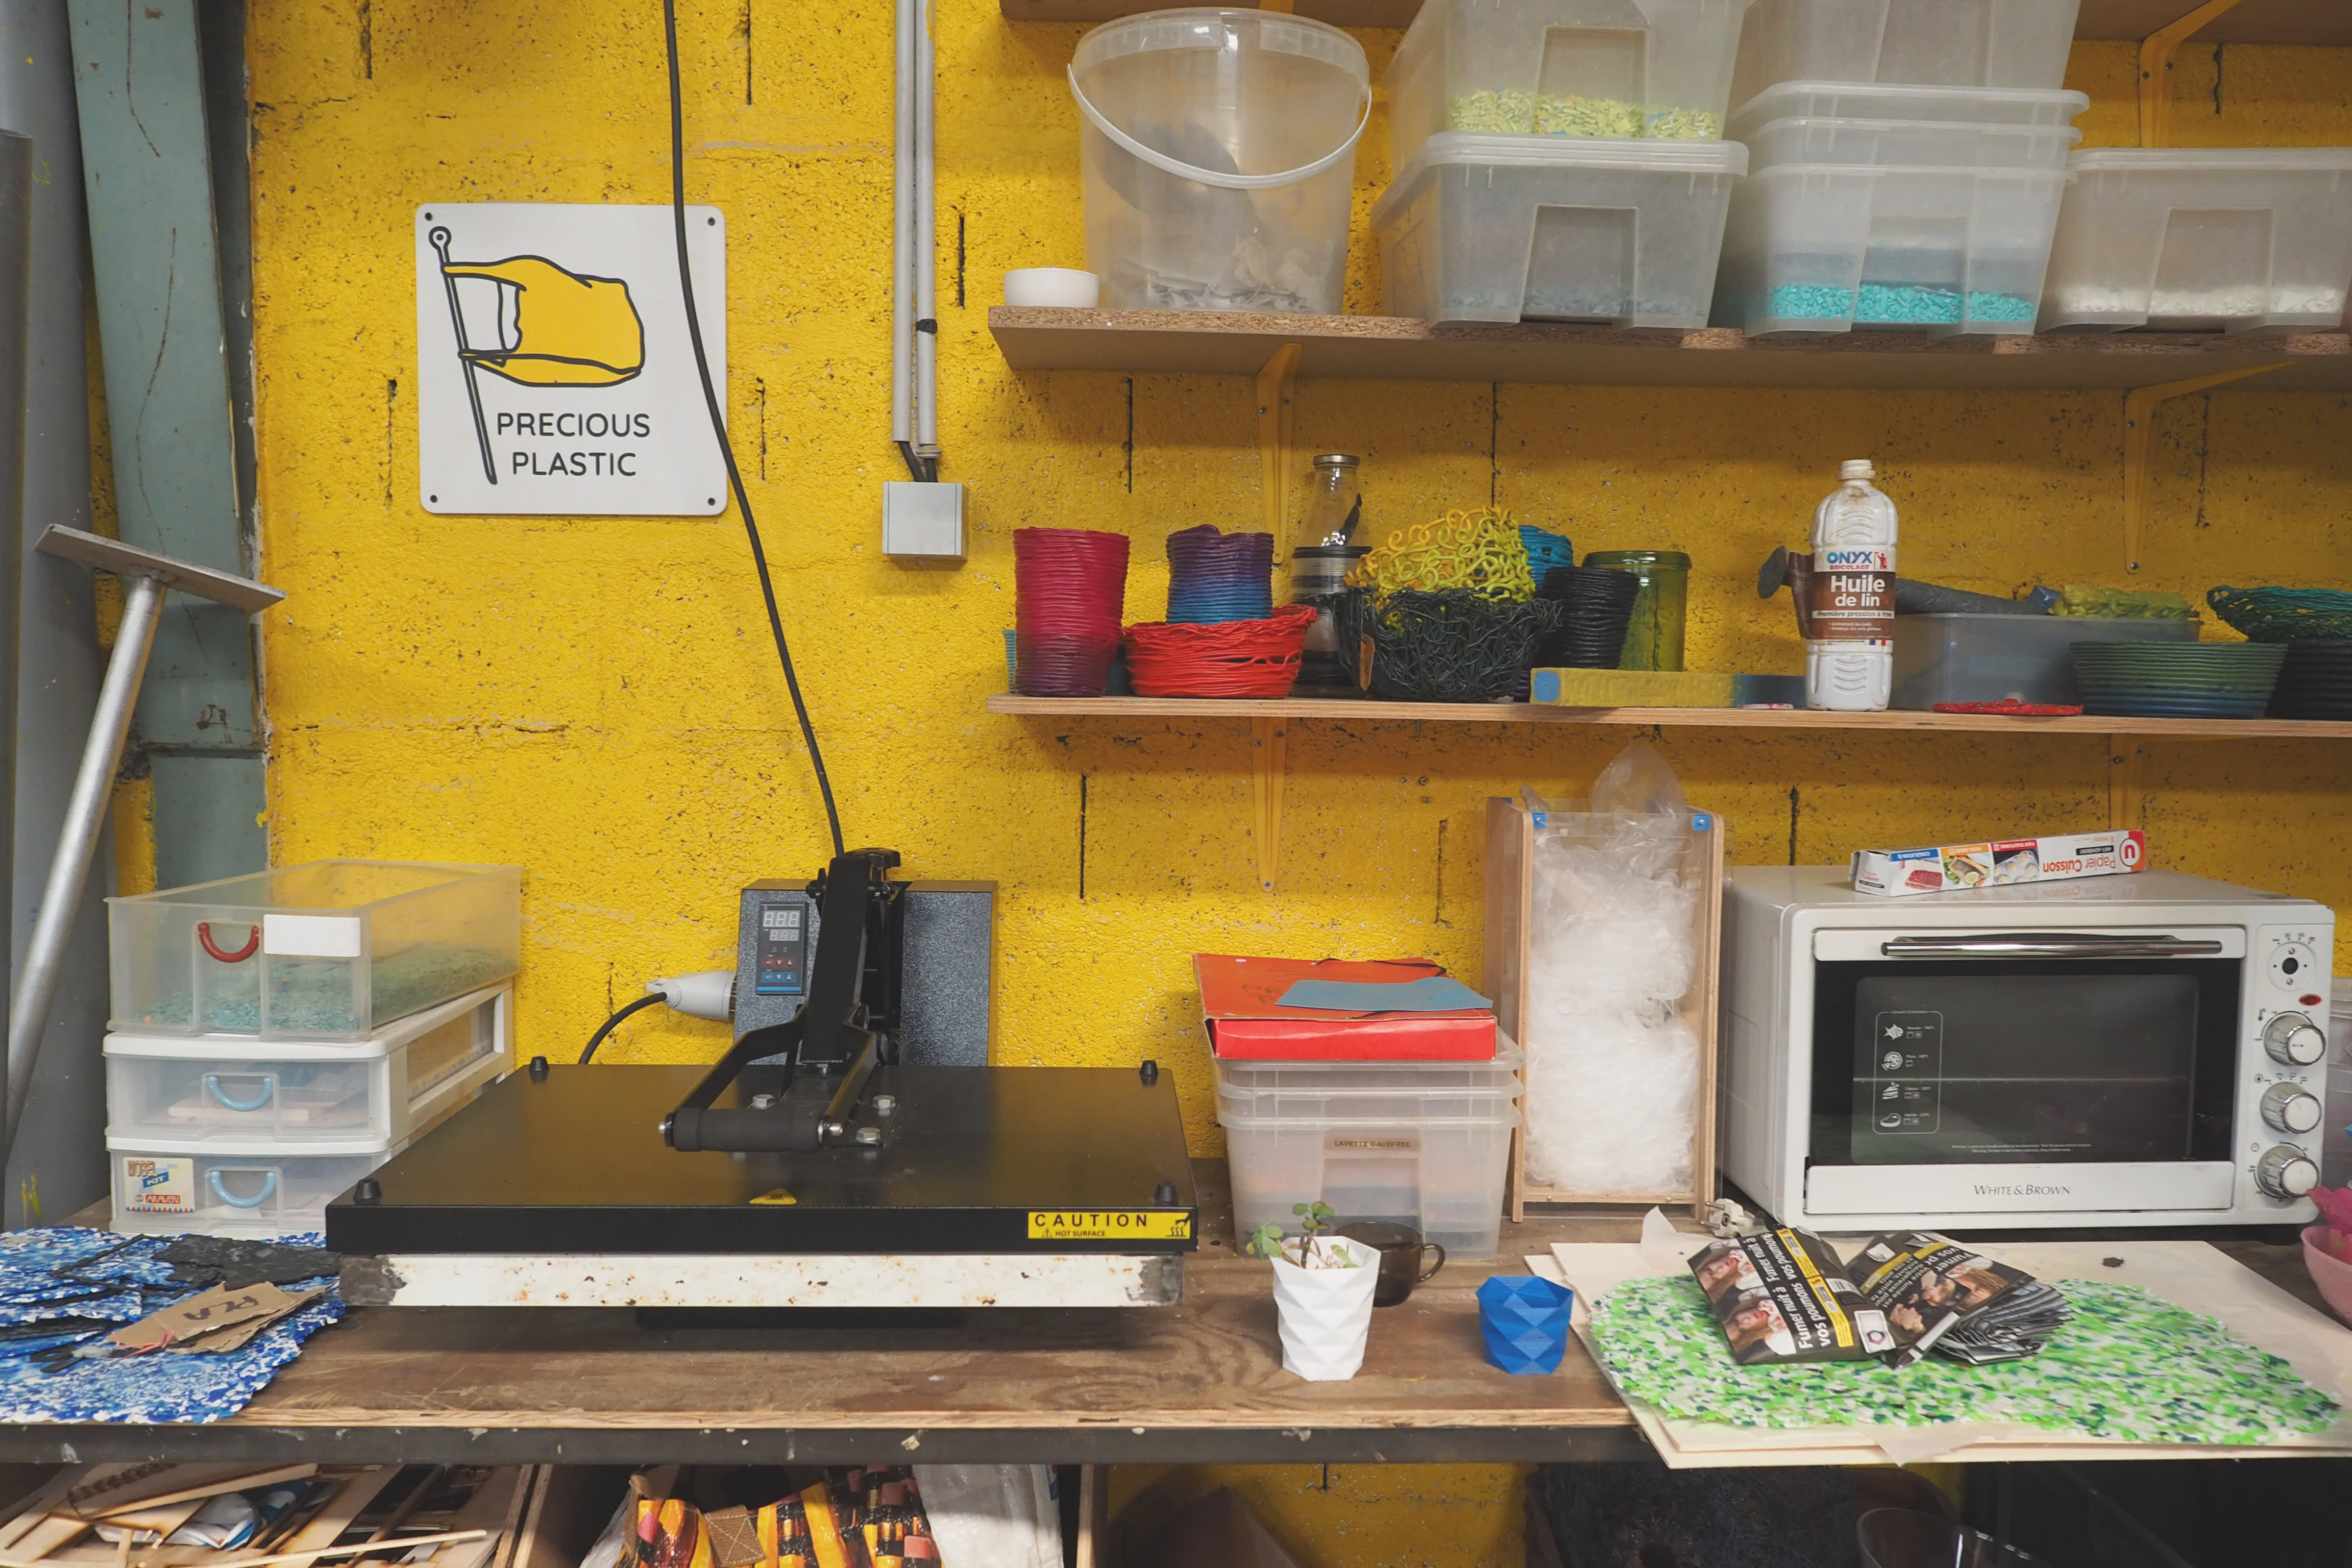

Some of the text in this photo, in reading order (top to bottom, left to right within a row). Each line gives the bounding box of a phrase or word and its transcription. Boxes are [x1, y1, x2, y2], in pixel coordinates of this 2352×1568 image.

[497, 412, 650, 437] PRECIOUS
[512, 452, 636, 476] PLASTIC
[1827, 551, 1873, 564] ONYX
[1830, 574, 1885, 592] Huile
[1834, 593, 1880, 606] de lin
[2124, 845, 2136, 859] U
[2043, 855, 2116, 873] Papier Cuisson
[146, 1175, 165, 1185] KIT
[1035, 1214, 1147, 1227] CAUTION
[1747, 1242, 1766, 1259] nuit
[1937, 1247, 1961, 1257] vos
[1757, 1259, 1781, 1282] Fumer
[1780, 1263, 1797, 1281] vos
[1888, 1263, 1924, 1293] dangereuse
[1891, 1280, 1914, 1298] fumée
[1791, 1282, 1827, 1322] poumons
[1882, 1297, 1894, 1309] est
[1772, 1286, 1814, 1349] Fumer nuit à
[1815, 1321, 1832, 1348] vos
